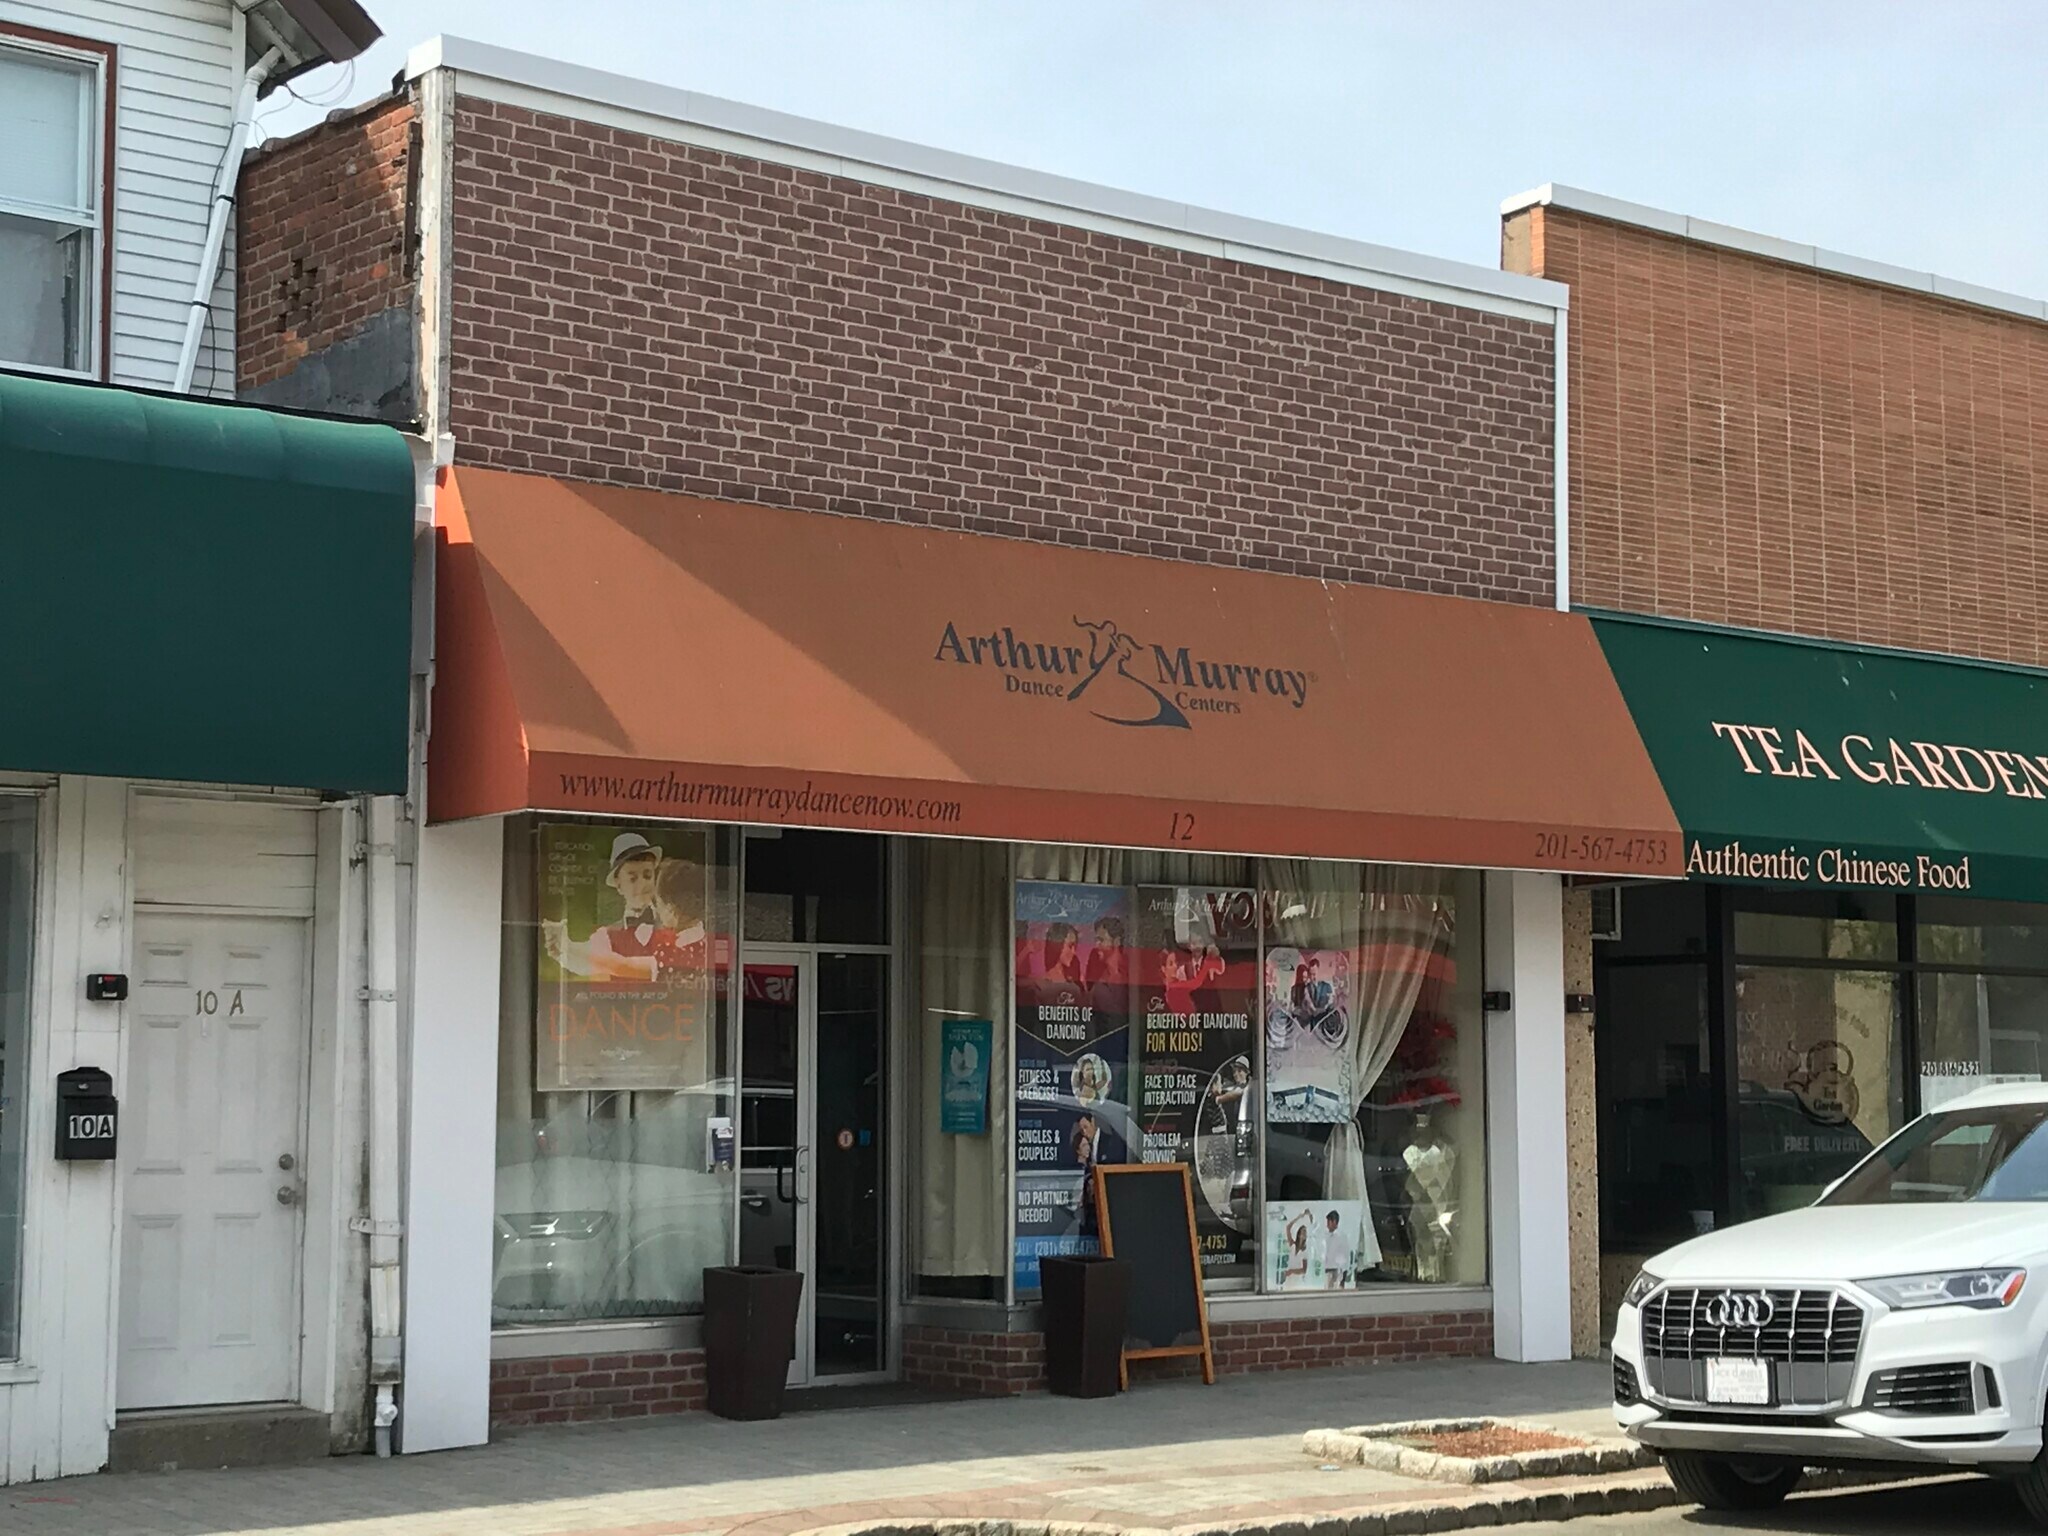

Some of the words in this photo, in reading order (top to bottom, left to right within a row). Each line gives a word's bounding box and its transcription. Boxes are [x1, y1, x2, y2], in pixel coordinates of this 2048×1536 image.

[934, 621, 1083, 674] Arthur
[1149, 644, 1308, 708] Murray
[1004, 674, 1064, 698] Dance
[1175, 692, 1241, 715] Centers
[1711, 721, 1841, 781] TEA
[1841, 735, 2048, 800] GARDEN
[560, 771, 962, 822] www.arthurmurraydancenow.com
[1168, 812, 1195, 841] 12
[1534, 832, 1668, 866] 201-567-4753
[1686, 840, 1810, 881] Authentic
[1817, 848, 1911, 887] Chinese
[1917, 855, 1971, 890] Food
[195, 989, 219, 1015] 10
[229, 989, 245, 1016] A
[1038, 1005, 1080, 1021] BENEFITS
[1081, 1007, 1093, 1022] OF
[1146, 1013, 1187, 1029] BENEFITS
[1188, 1014, 1201, 1029] OF
[1203, 1014, 1248, 1030] DANCING
[550, 1003, 694, 1042] DANCE
[1046, 1024, 1086, 1040] DANCING
[1145, 1032, 1167, 1052] FOR
[1169, 1032, 1202, 1052] KIDS!
[1018, 1069, 1052, 1084] FITNESS
[1053, 1069, 1060, 1084] &
[1144, 1074, 1163, 1089] FACE
[1164, 1074, 1175, 1089] TO
[1176, 1074, 1197, 1089] FACE
[1144, 1090, 1196, 1106] INTERACTION
[70, 1115, 113, 1138] 10A
[1018, 1129, 1053, 1144] SINGLES
[1054, 1129, 1060, 1144] &
[1142, 1132, 1181, 1148] PROBLEM
[1784, 1135, 1810, 1153] FREE
[1813, 1135, 1861, 1152] DELIVERY
[1018, 1147, 1058, 1161] COUPLES!
[1018, 1191, 1031, 1205] NO
[1033, 1191, 1069, 1206] PARTNER
[1018, 1208, 1053, 1223] NEEDED!
[1197, 1234, 1227, 1249] 7-4753
